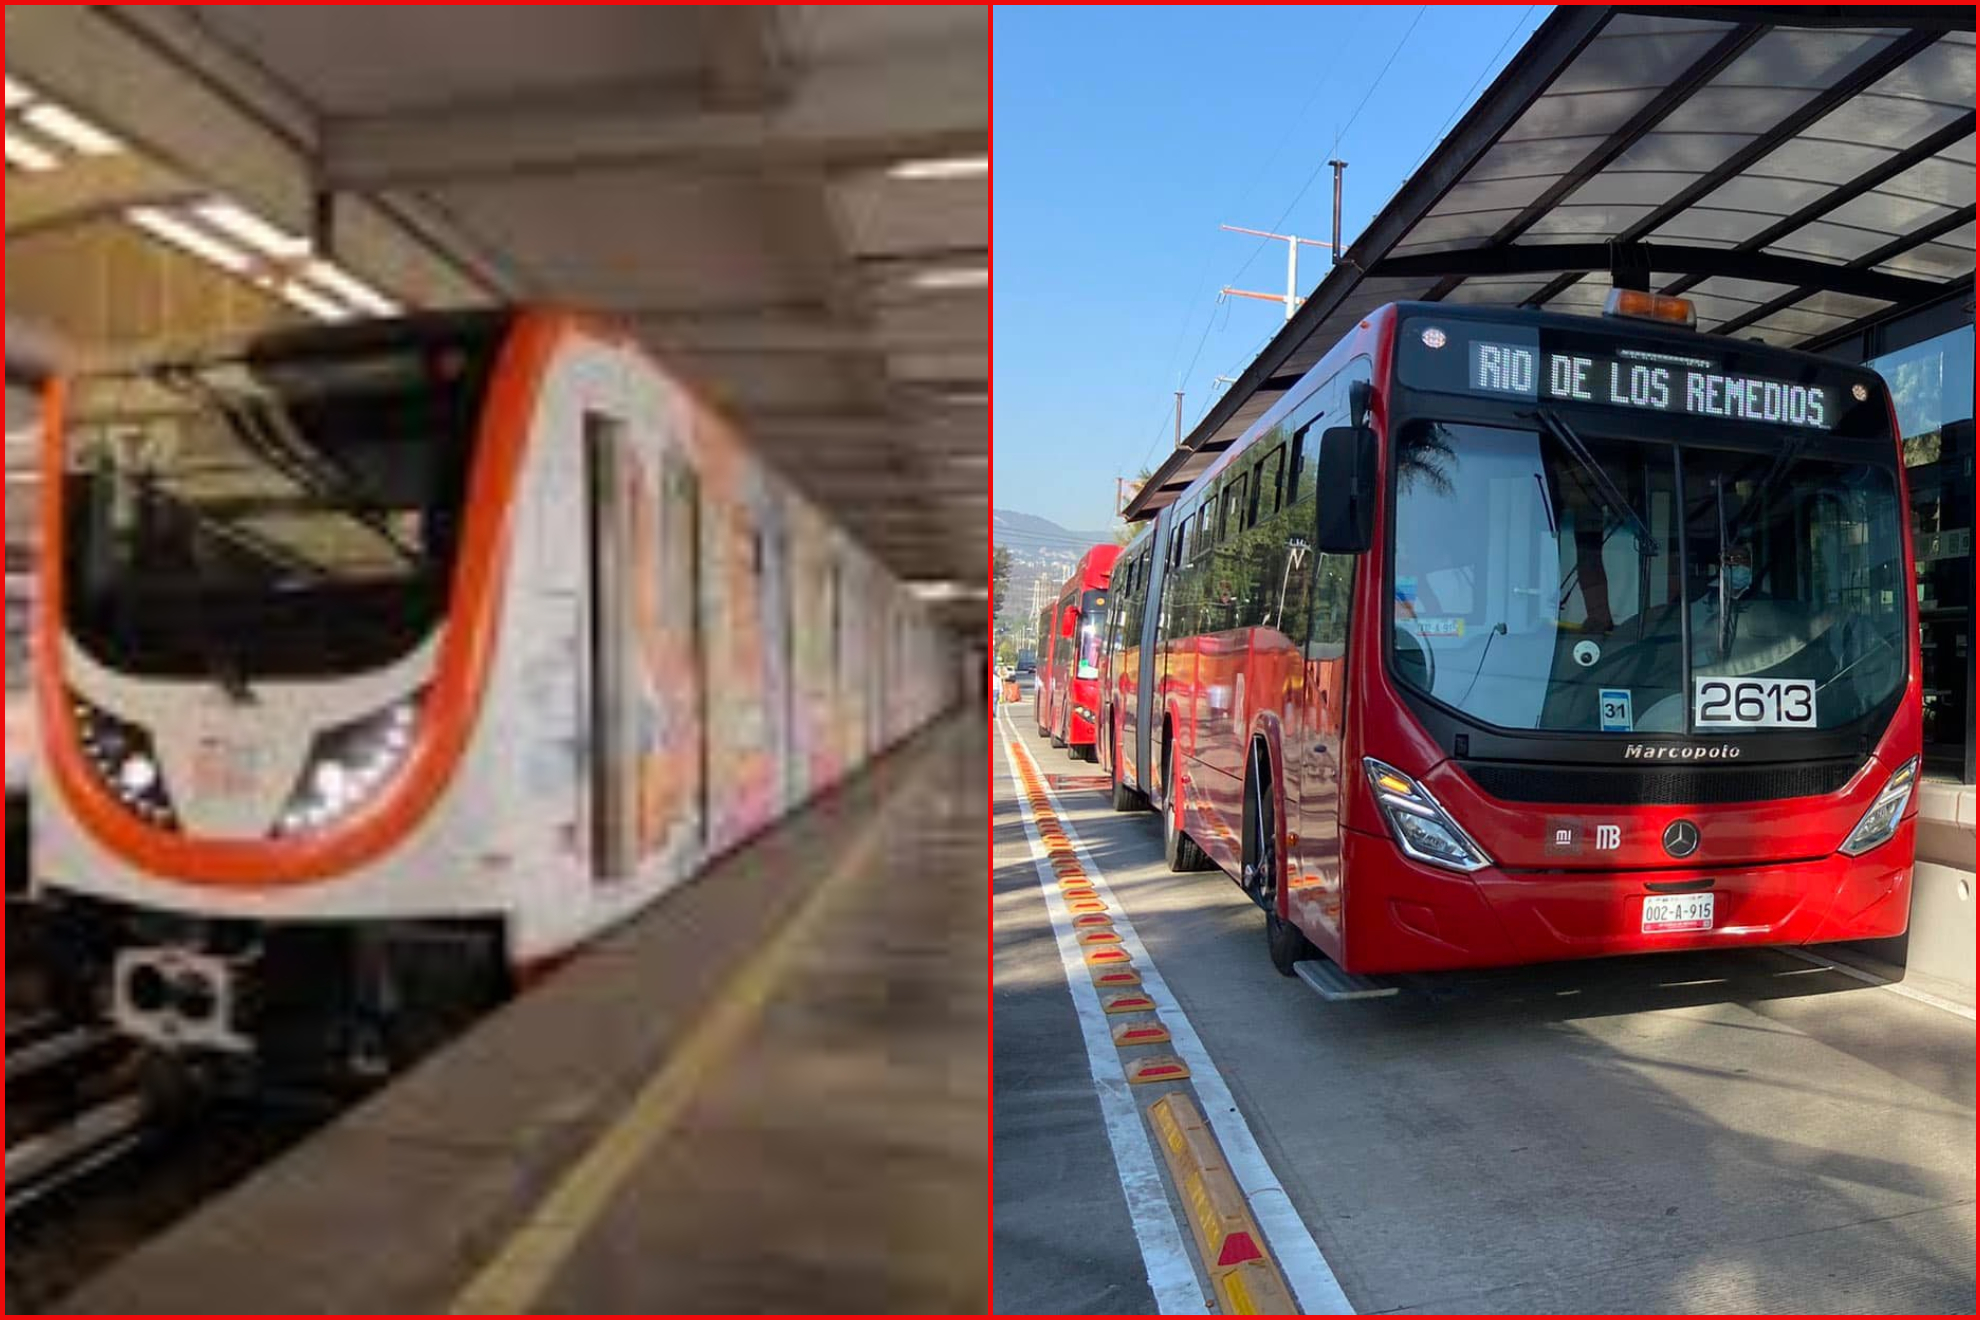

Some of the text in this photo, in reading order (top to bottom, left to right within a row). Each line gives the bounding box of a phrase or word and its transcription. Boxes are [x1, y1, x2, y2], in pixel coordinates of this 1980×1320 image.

[1479, 345, 1824, 426] RIO DE LOS REMEDIOS
[1604, 703, 1625, 718] 31
[1701, 682, 1812, 722] 2613
[1624, 744, 1740, 760] Marcopolo
[1646, 903, 1711, 921] 002-A-915
